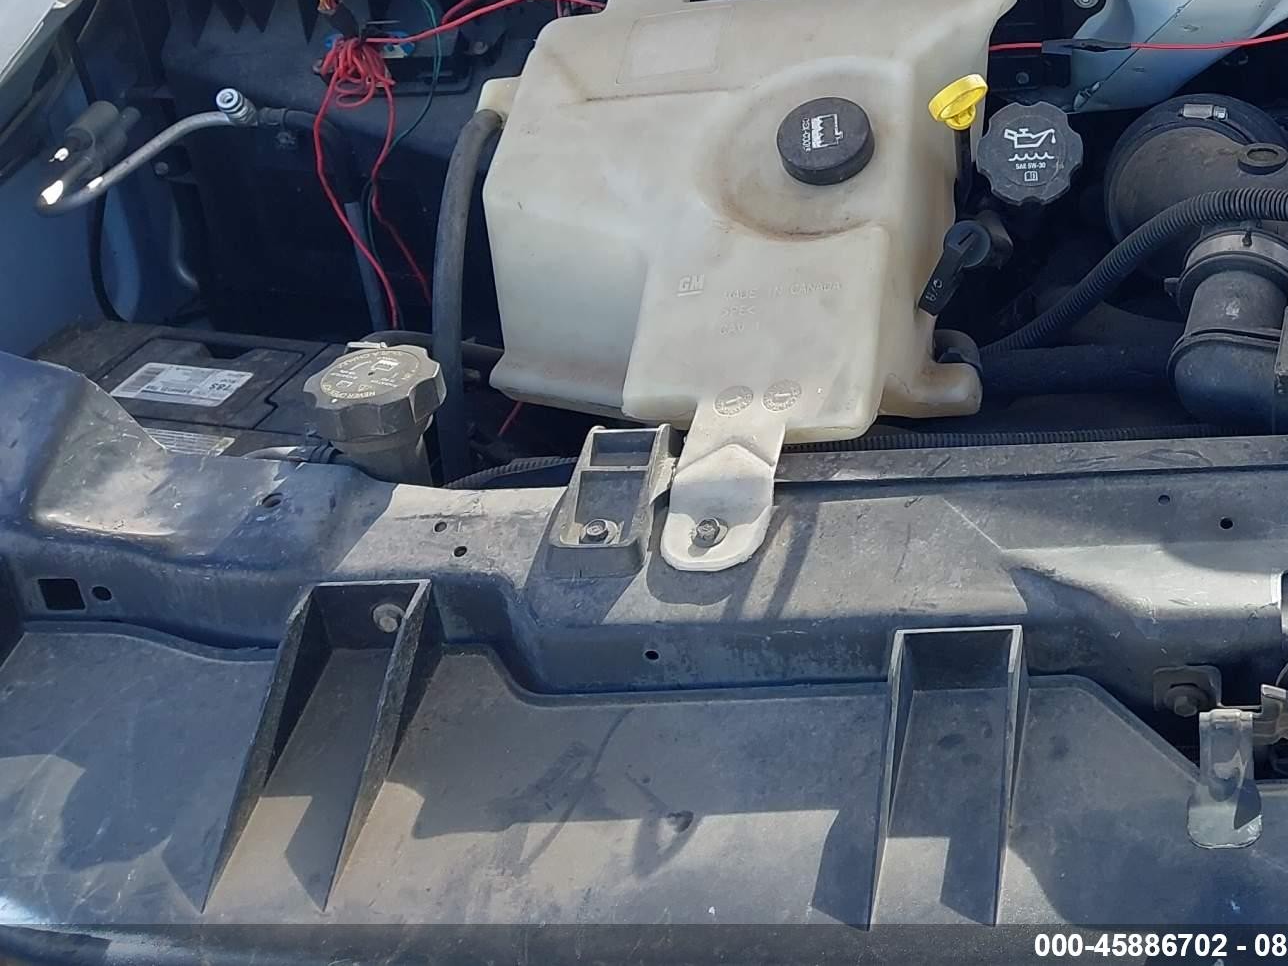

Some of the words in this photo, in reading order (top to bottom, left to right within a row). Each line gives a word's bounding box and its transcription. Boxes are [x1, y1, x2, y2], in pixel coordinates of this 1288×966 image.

[679, 274, 704, 292] GM
[769, 284, 784, 297] IN
[790, 281, 842, 295] CANADA
